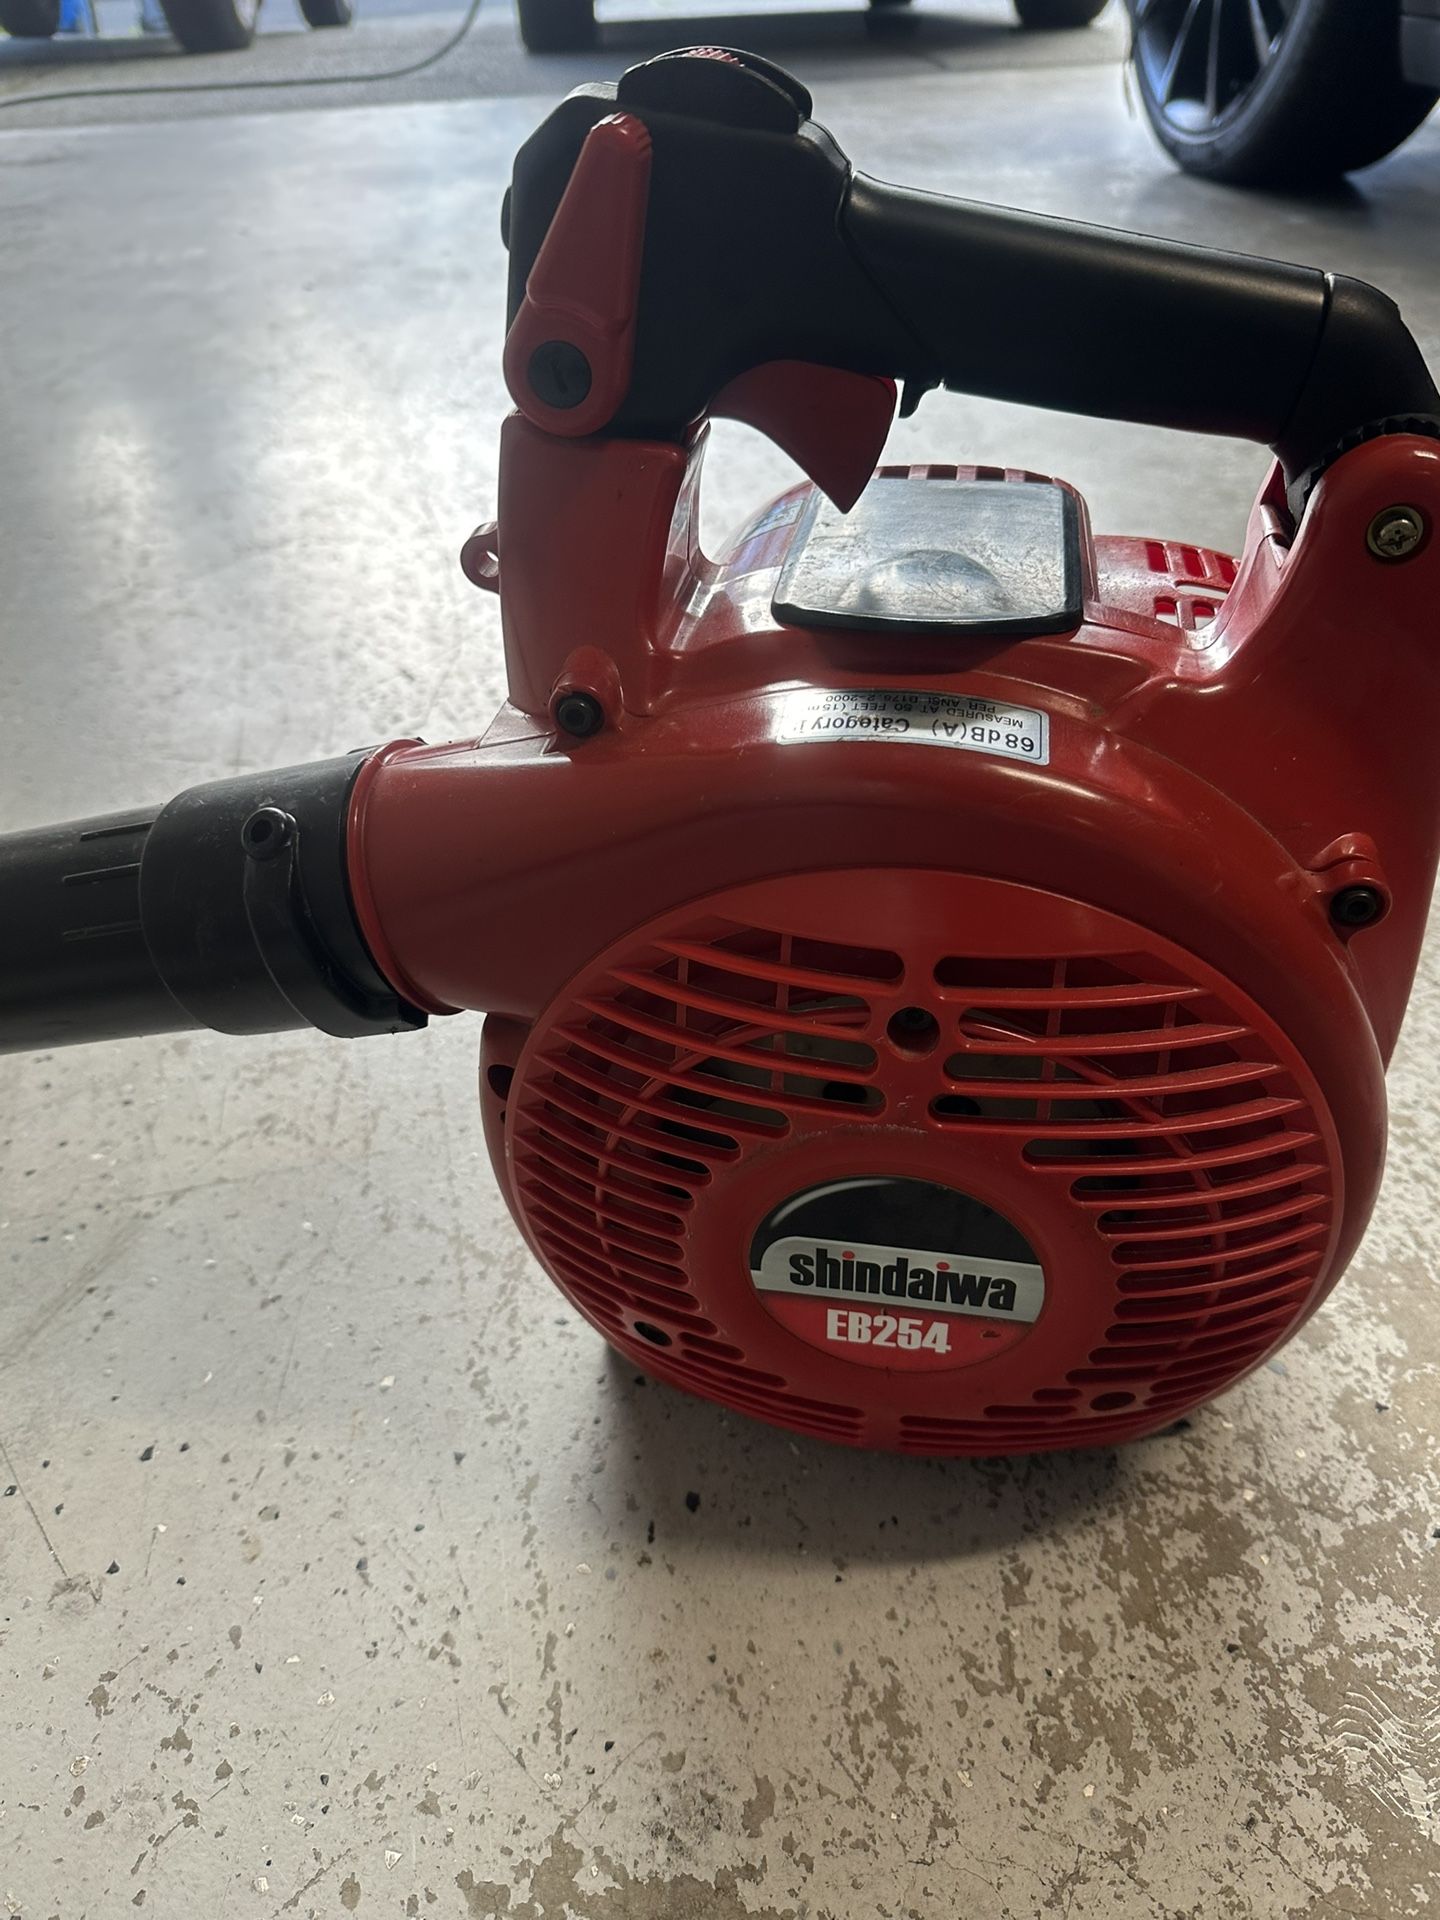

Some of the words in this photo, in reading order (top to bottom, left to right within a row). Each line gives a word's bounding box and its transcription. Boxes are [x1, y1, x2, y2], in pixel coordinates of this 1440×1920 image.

[852, 702, 886, 711] FEET
[894, 702, 913, 712] 50
[922, 702, 939, 714] AT
[928, 697, 960, 708] ANSI
[969, 700, 996, 713] PER
[811, 715, 910, 732] Category
[946, 707, 1023, 728] MEASURED
[788, 1248, 1017, 1311] shindaiwa
[826, 1308, 952, 1353] EB254
